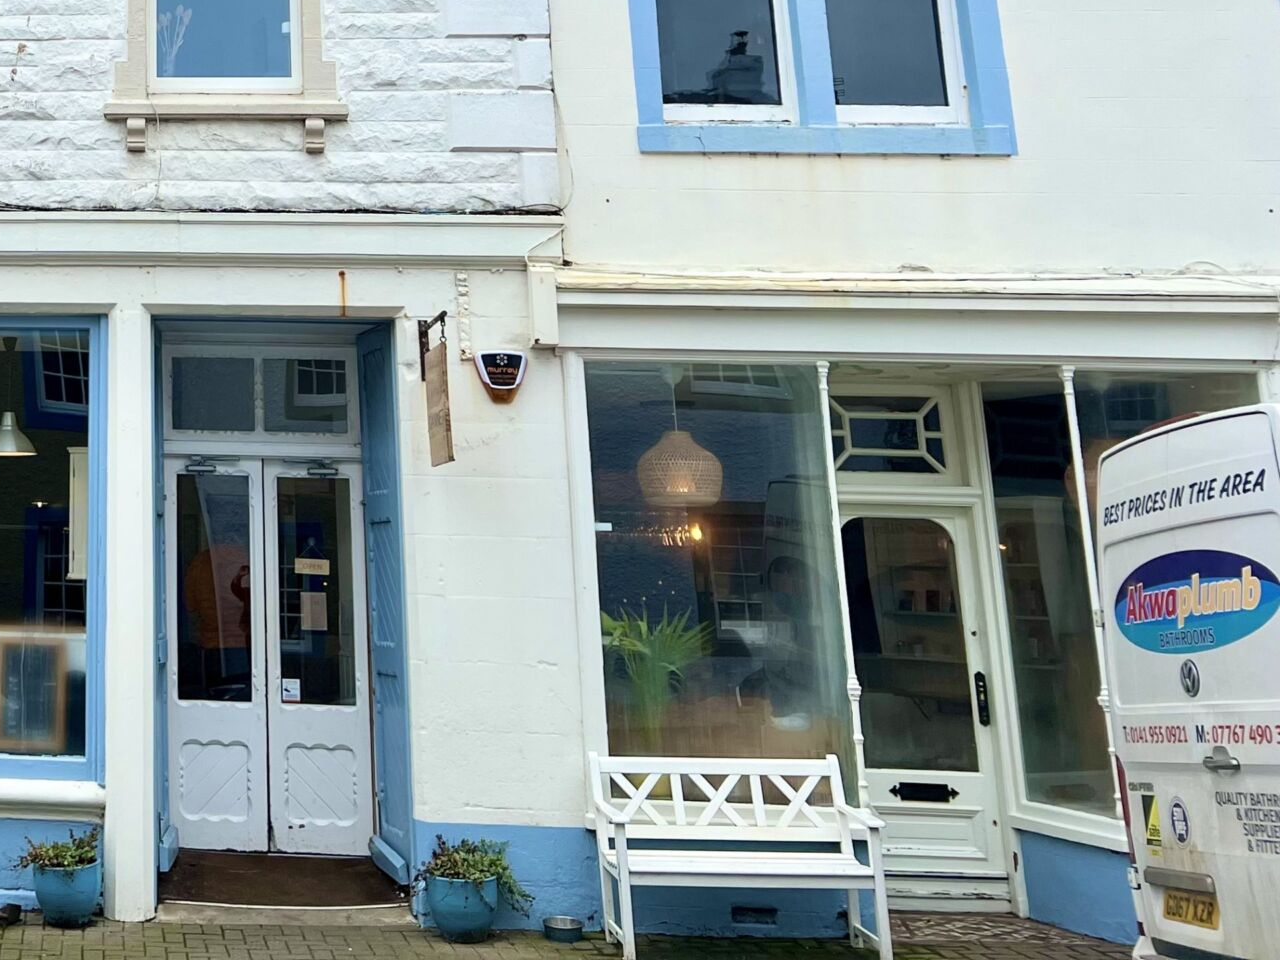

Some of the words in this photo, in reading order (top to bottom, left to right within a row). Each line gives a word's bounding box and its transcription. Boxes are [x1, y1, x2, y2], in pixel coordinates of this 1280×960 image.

[487, 366, 518, 375] murray
[1104, 501, 1126, 527] BEST
[1128, 490, 1167, 519] PRICES
[1169, 485, 1185, 509] IN
[1189, 478, 1217, 504] THE
[1219, 468, 1266, 498] AREA
[303, 562, 323, 571] OPEN
[1125, 565, 1261, 629] Akwaplumb
[1159, 628, 1215, 649] BATHROOMS
[1149, 725, 1164, 744] 955
[1165, 725, 1189, 744] 0921
[1195, 724, 1210, 743] M:
[1212, 724, 1245, 744] 07767
[1249, 724, 1273, 744] 490
[1215, 791, 1248, 807] QUALITY
